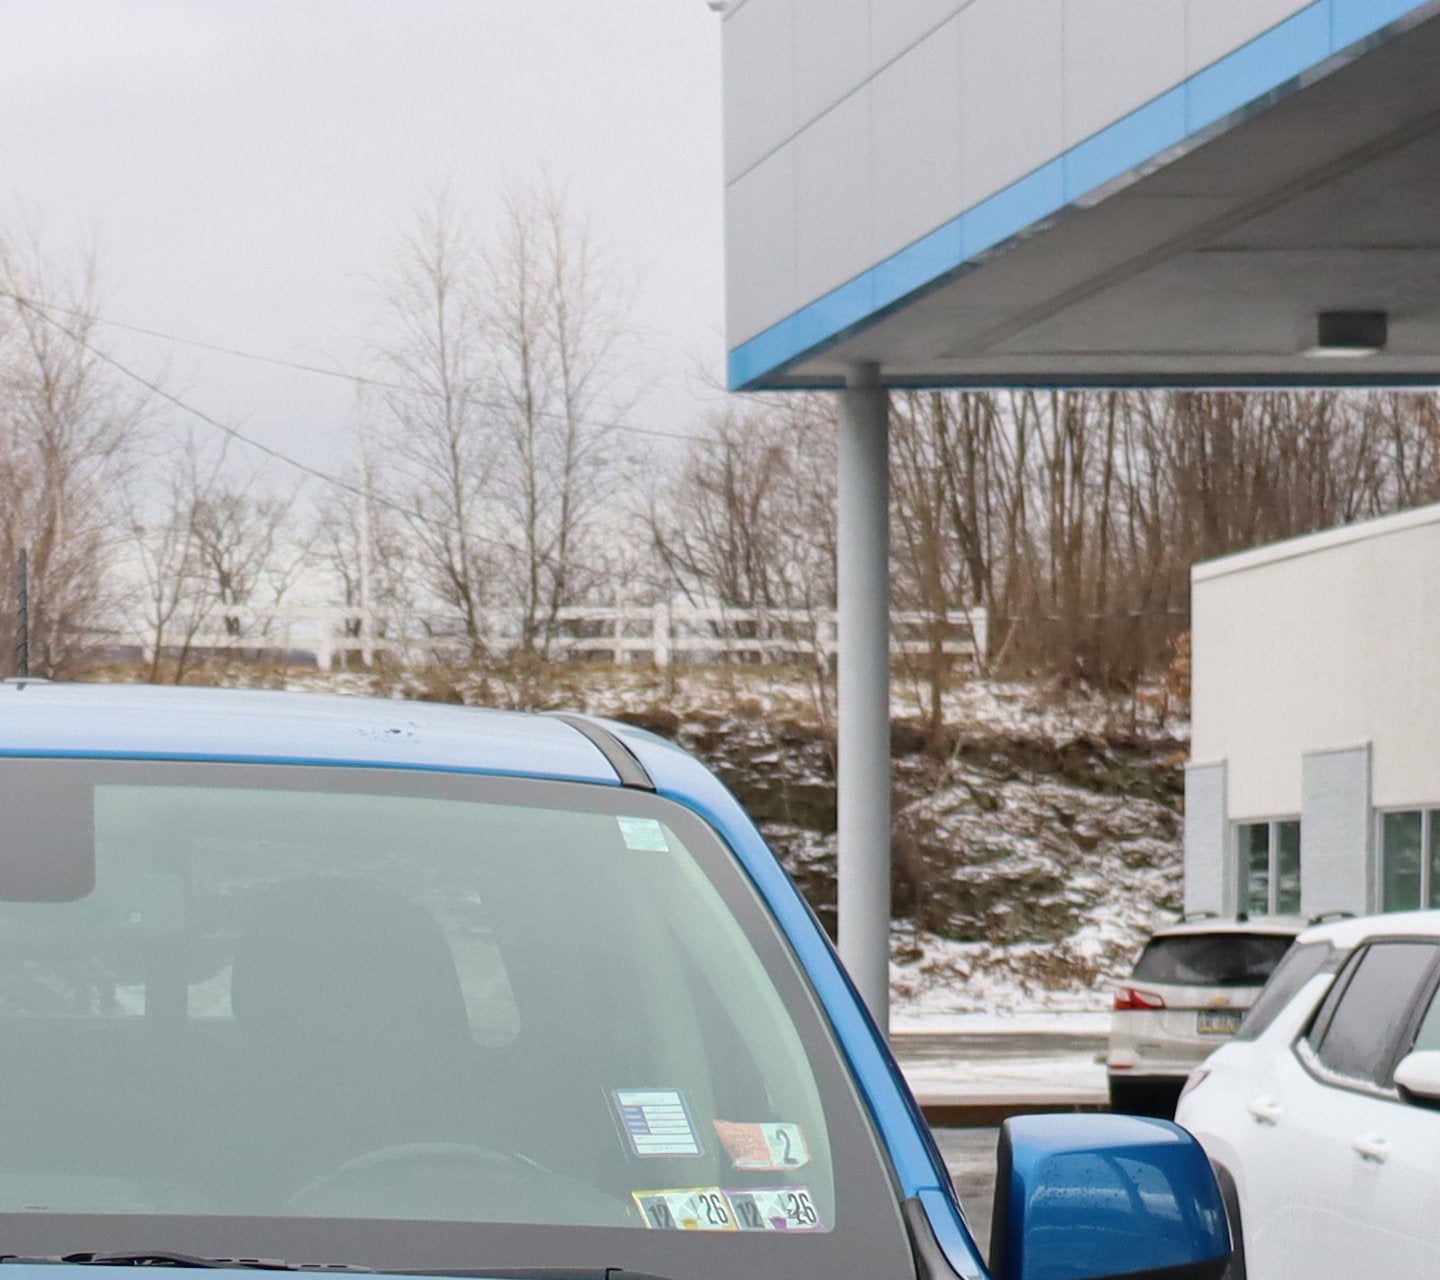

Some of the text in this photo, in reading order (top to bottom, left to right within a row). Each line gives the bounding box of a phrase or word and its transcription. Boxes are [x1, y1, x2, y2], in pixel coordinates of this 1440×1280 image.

[775, 1128, 798, 1165] 2
[699, 1193, 728, 1226] 26
[736, 1201, 765, 1229] 12
